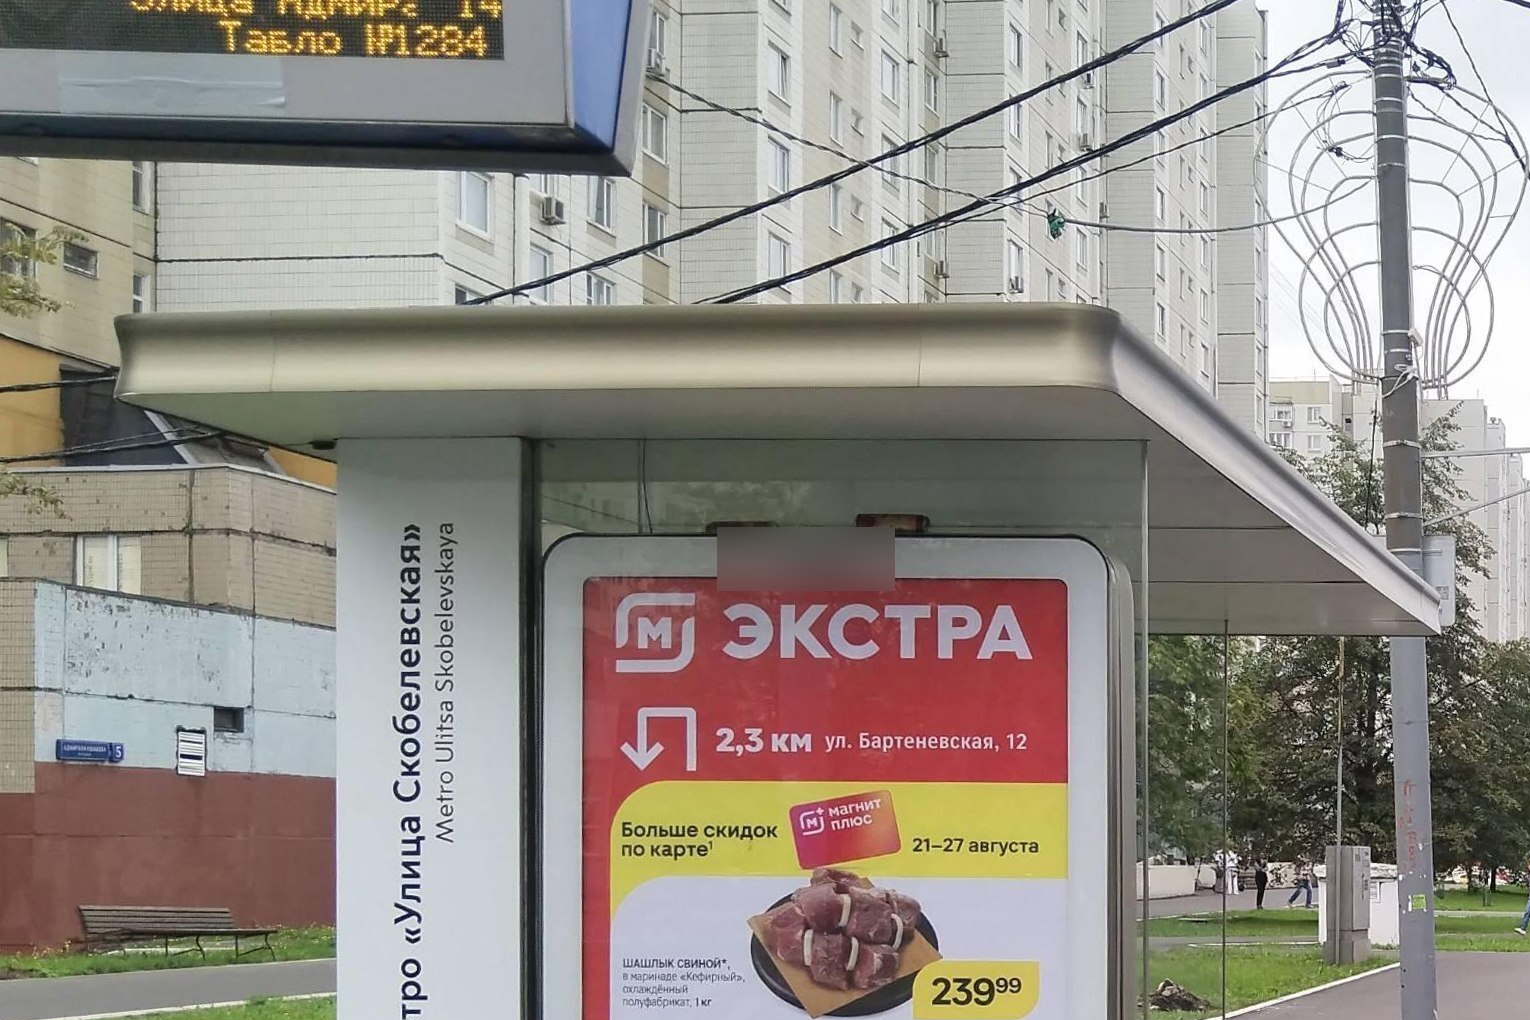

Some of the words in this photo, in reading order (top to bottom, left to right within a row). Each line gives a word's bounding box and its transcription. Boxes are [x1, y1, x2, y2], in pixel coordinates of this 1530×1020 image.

[219, 20, 343, 55] Табло
[434, 522, 458, 692] Skobelevskaya
[721, 602, 1034, 661] ЭКСТРА
[392, 523, 422, 802] Скобелевская»
[434, 696, 455, 766] Ulitsa
[715, 728, 764, 757] 2,3
[772, 733, 812, 753] км
[825, 734, 852, 753] ул.
[858, 731, 1000, 753] Бартеневская,
[1006, 733, 1028, 751] 12
[115, 745, 122, 759] 5
[435, 771, 454, 843] Metro
[621, 821, 699, 839] Больше
[703, 824, 778, 839] скидок
[621, 845, 646, 857] по
[968, 839, 1039, 857] августа
[394, 815, 425, 943] «Улица
[622, 958, 674, 969] ШАШЛЫК
[631, 973, 677, 982] маринаде
[622, 984, 688, 995] охлаждённый
[931, 977, 995, 1006] 239
[996, 977, 1022, 994] 99
